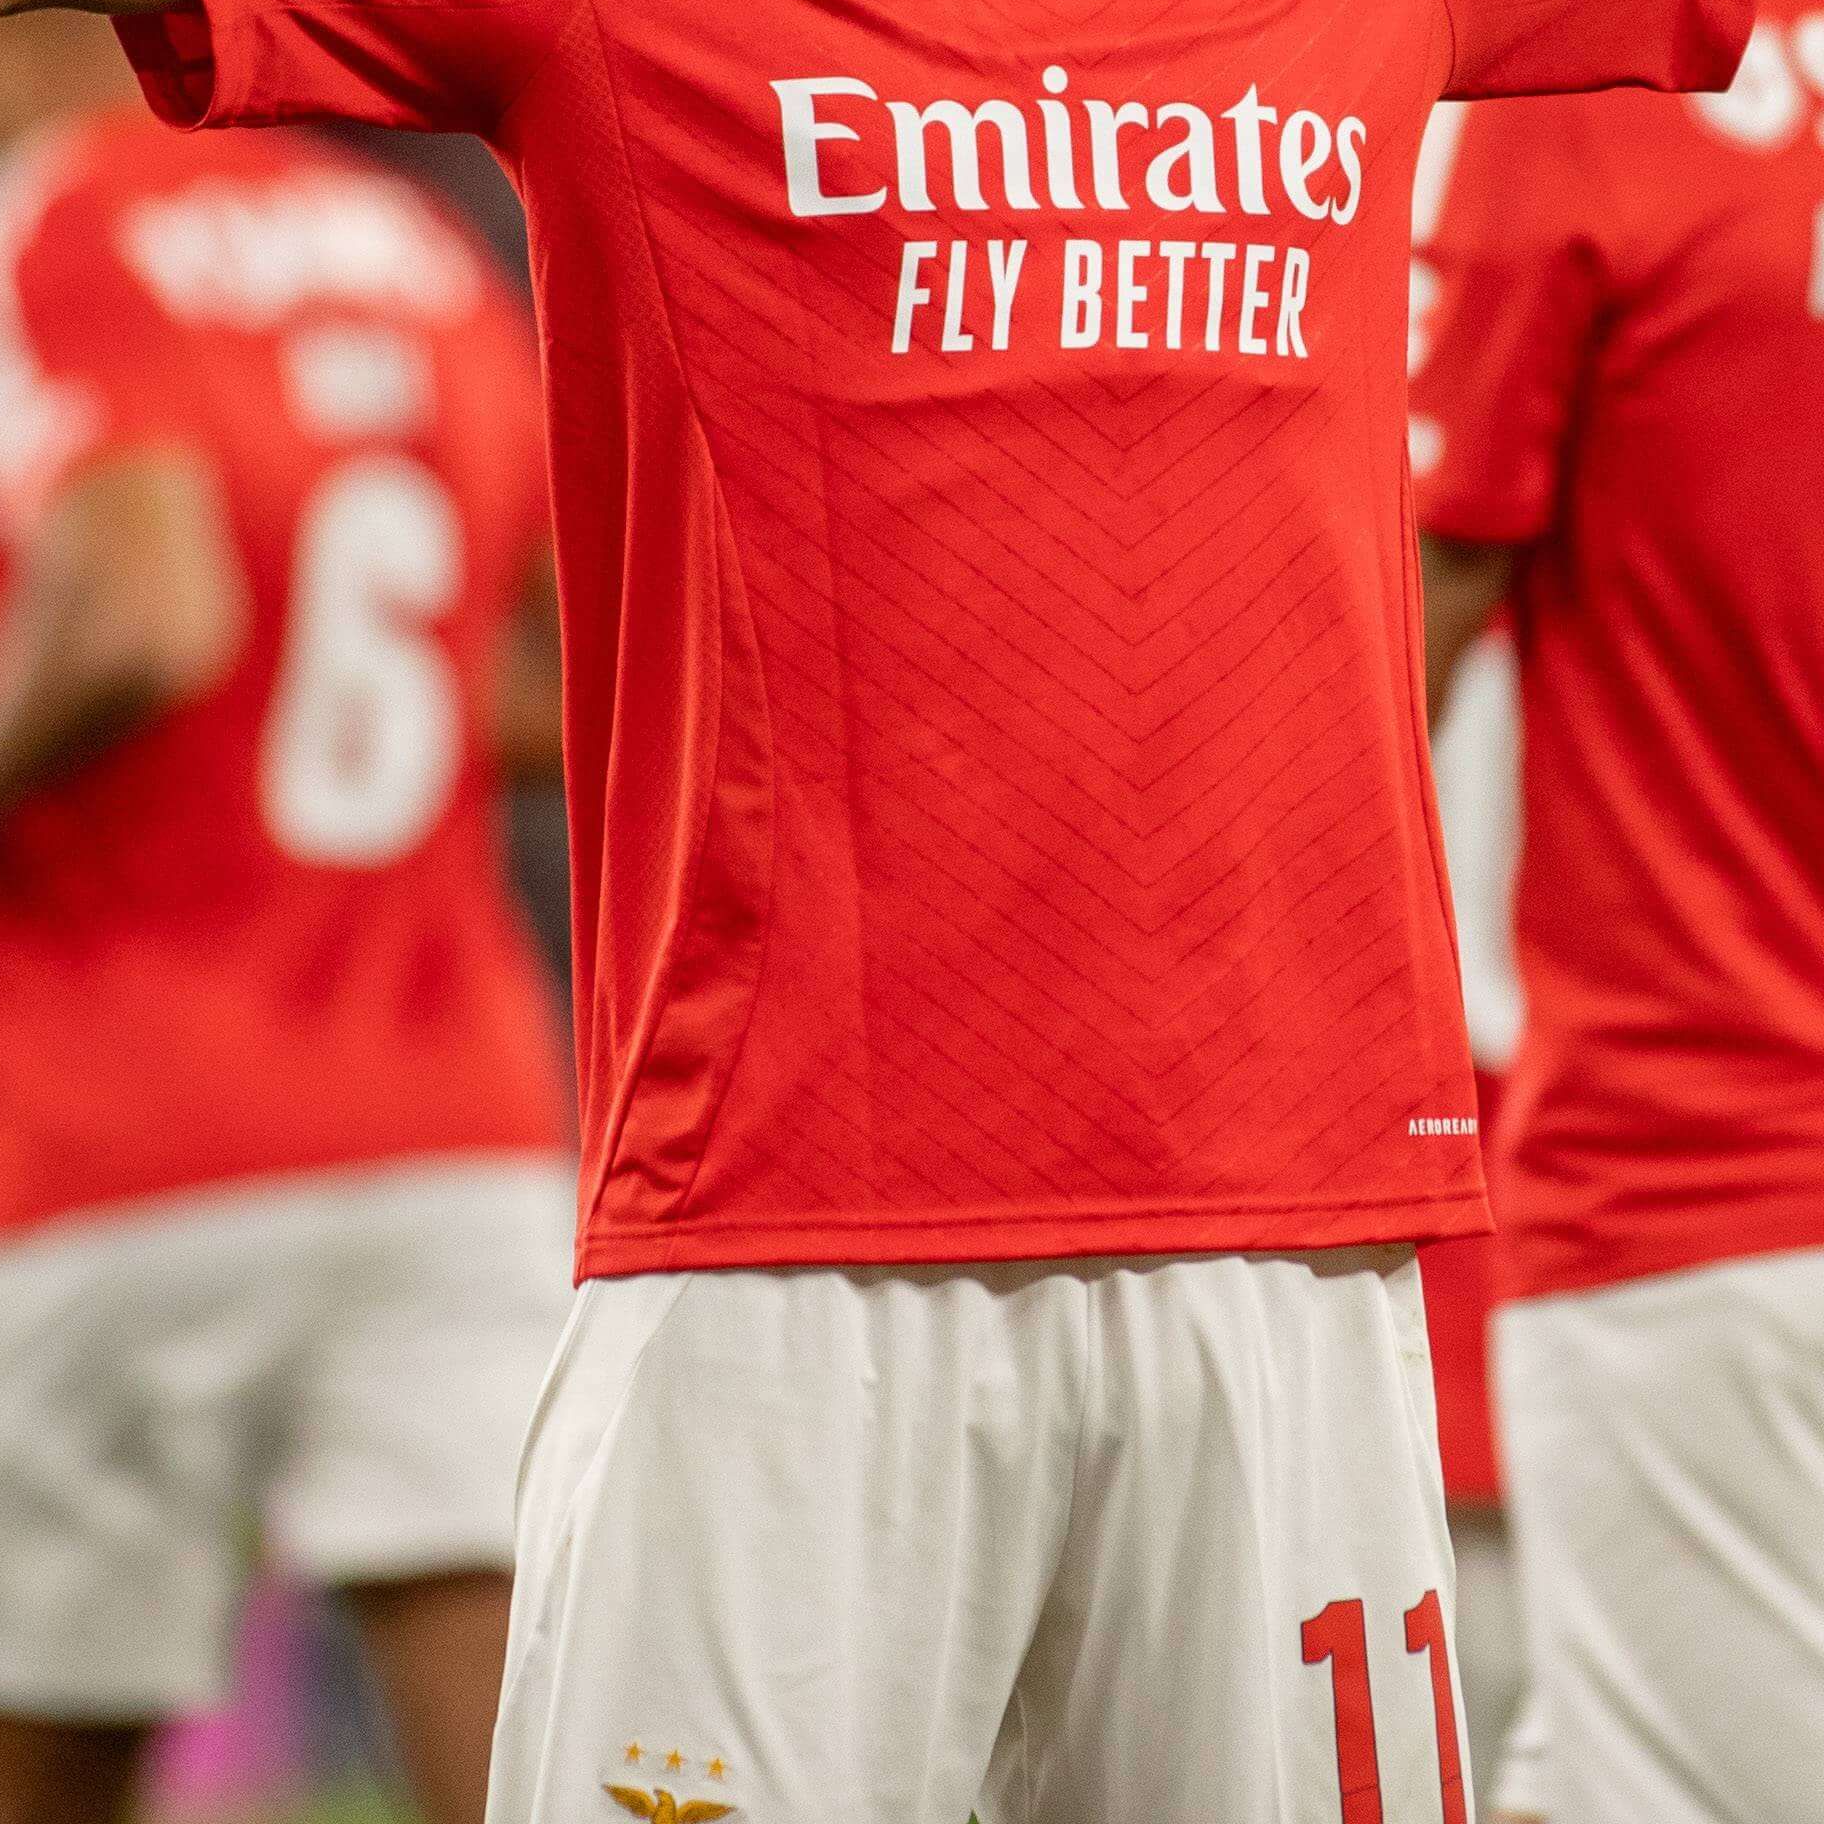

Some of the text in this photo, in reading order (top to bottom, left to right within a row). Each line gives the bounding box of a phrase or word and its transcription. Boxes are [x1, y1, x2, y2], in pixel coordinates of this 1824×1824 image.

[769, 65, 1367, 227] Emirates
[890, 238, 1312, 359] FLY BETTER
[259, 444, 466, 868] 6
[1300, 1589, 1468, 1824] 11
